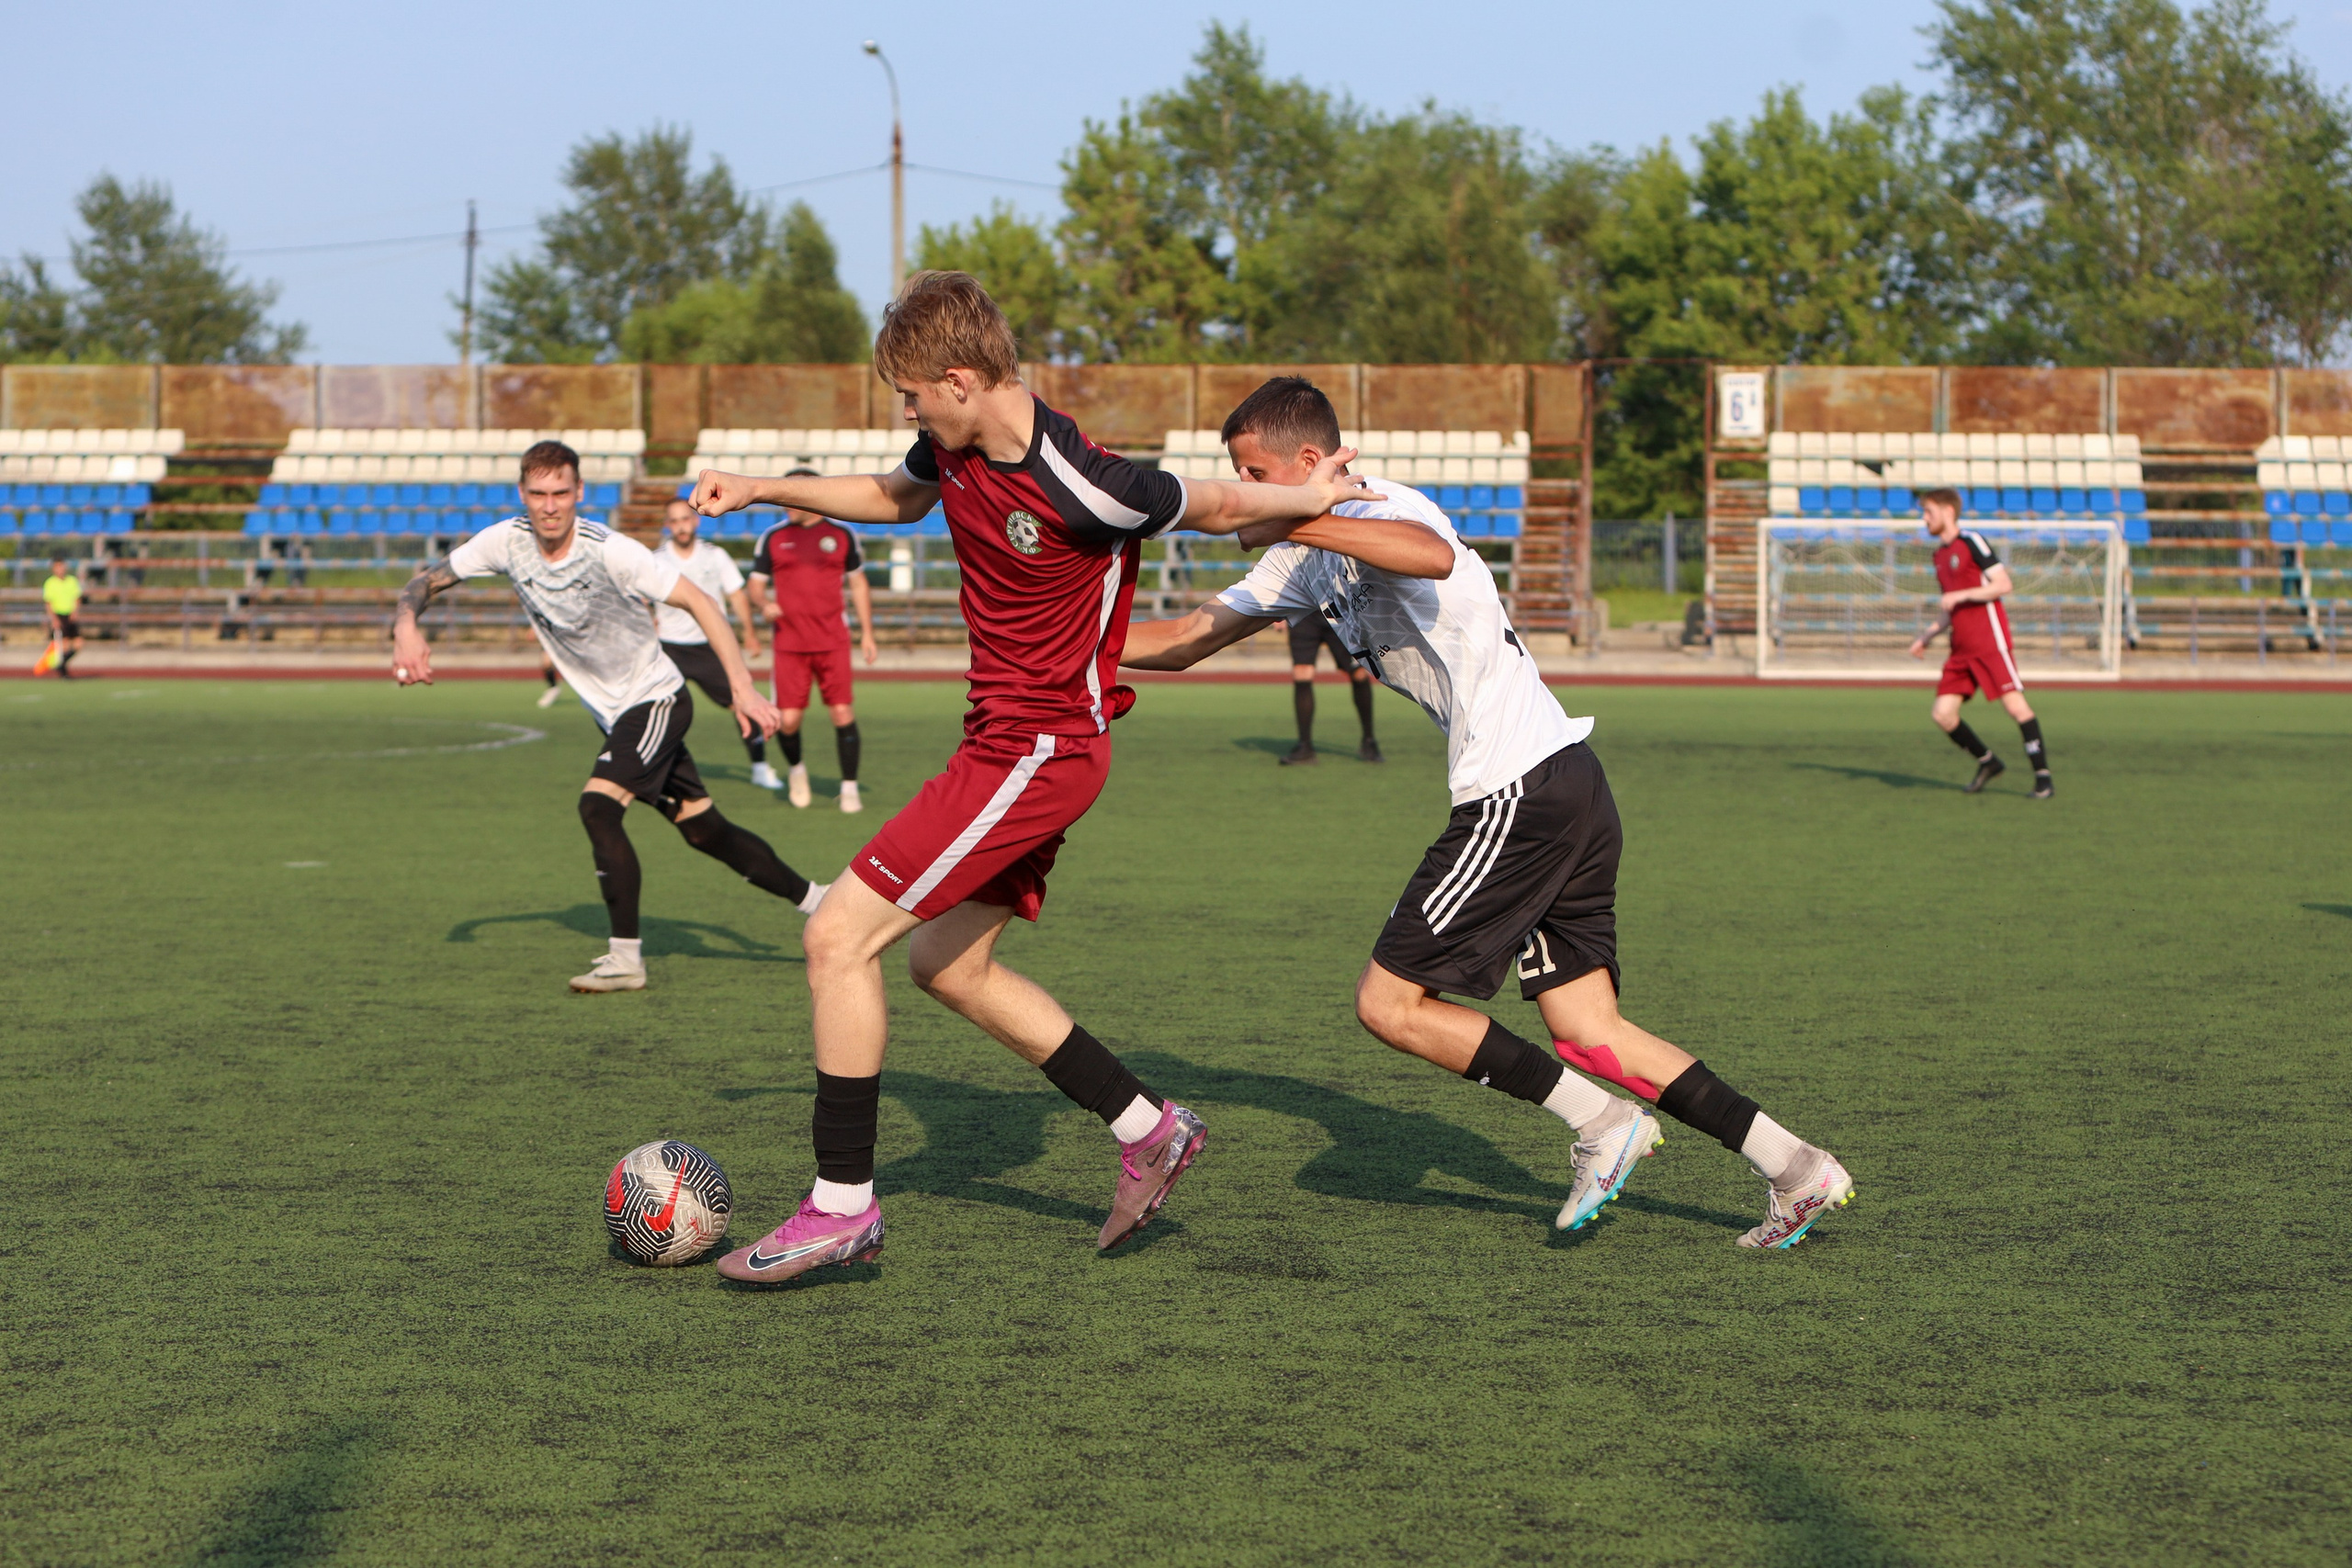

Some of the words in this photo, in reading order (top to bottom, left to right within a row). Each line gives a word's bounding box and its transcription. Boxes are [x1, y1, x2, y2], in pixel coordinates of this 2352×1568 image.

[1731, 391, 1744, 423] 6
[950, 475, 965, 491] SPORT
[878, 865, 904, 885] SPORT
[1517, 928, 1556, 980] 21
